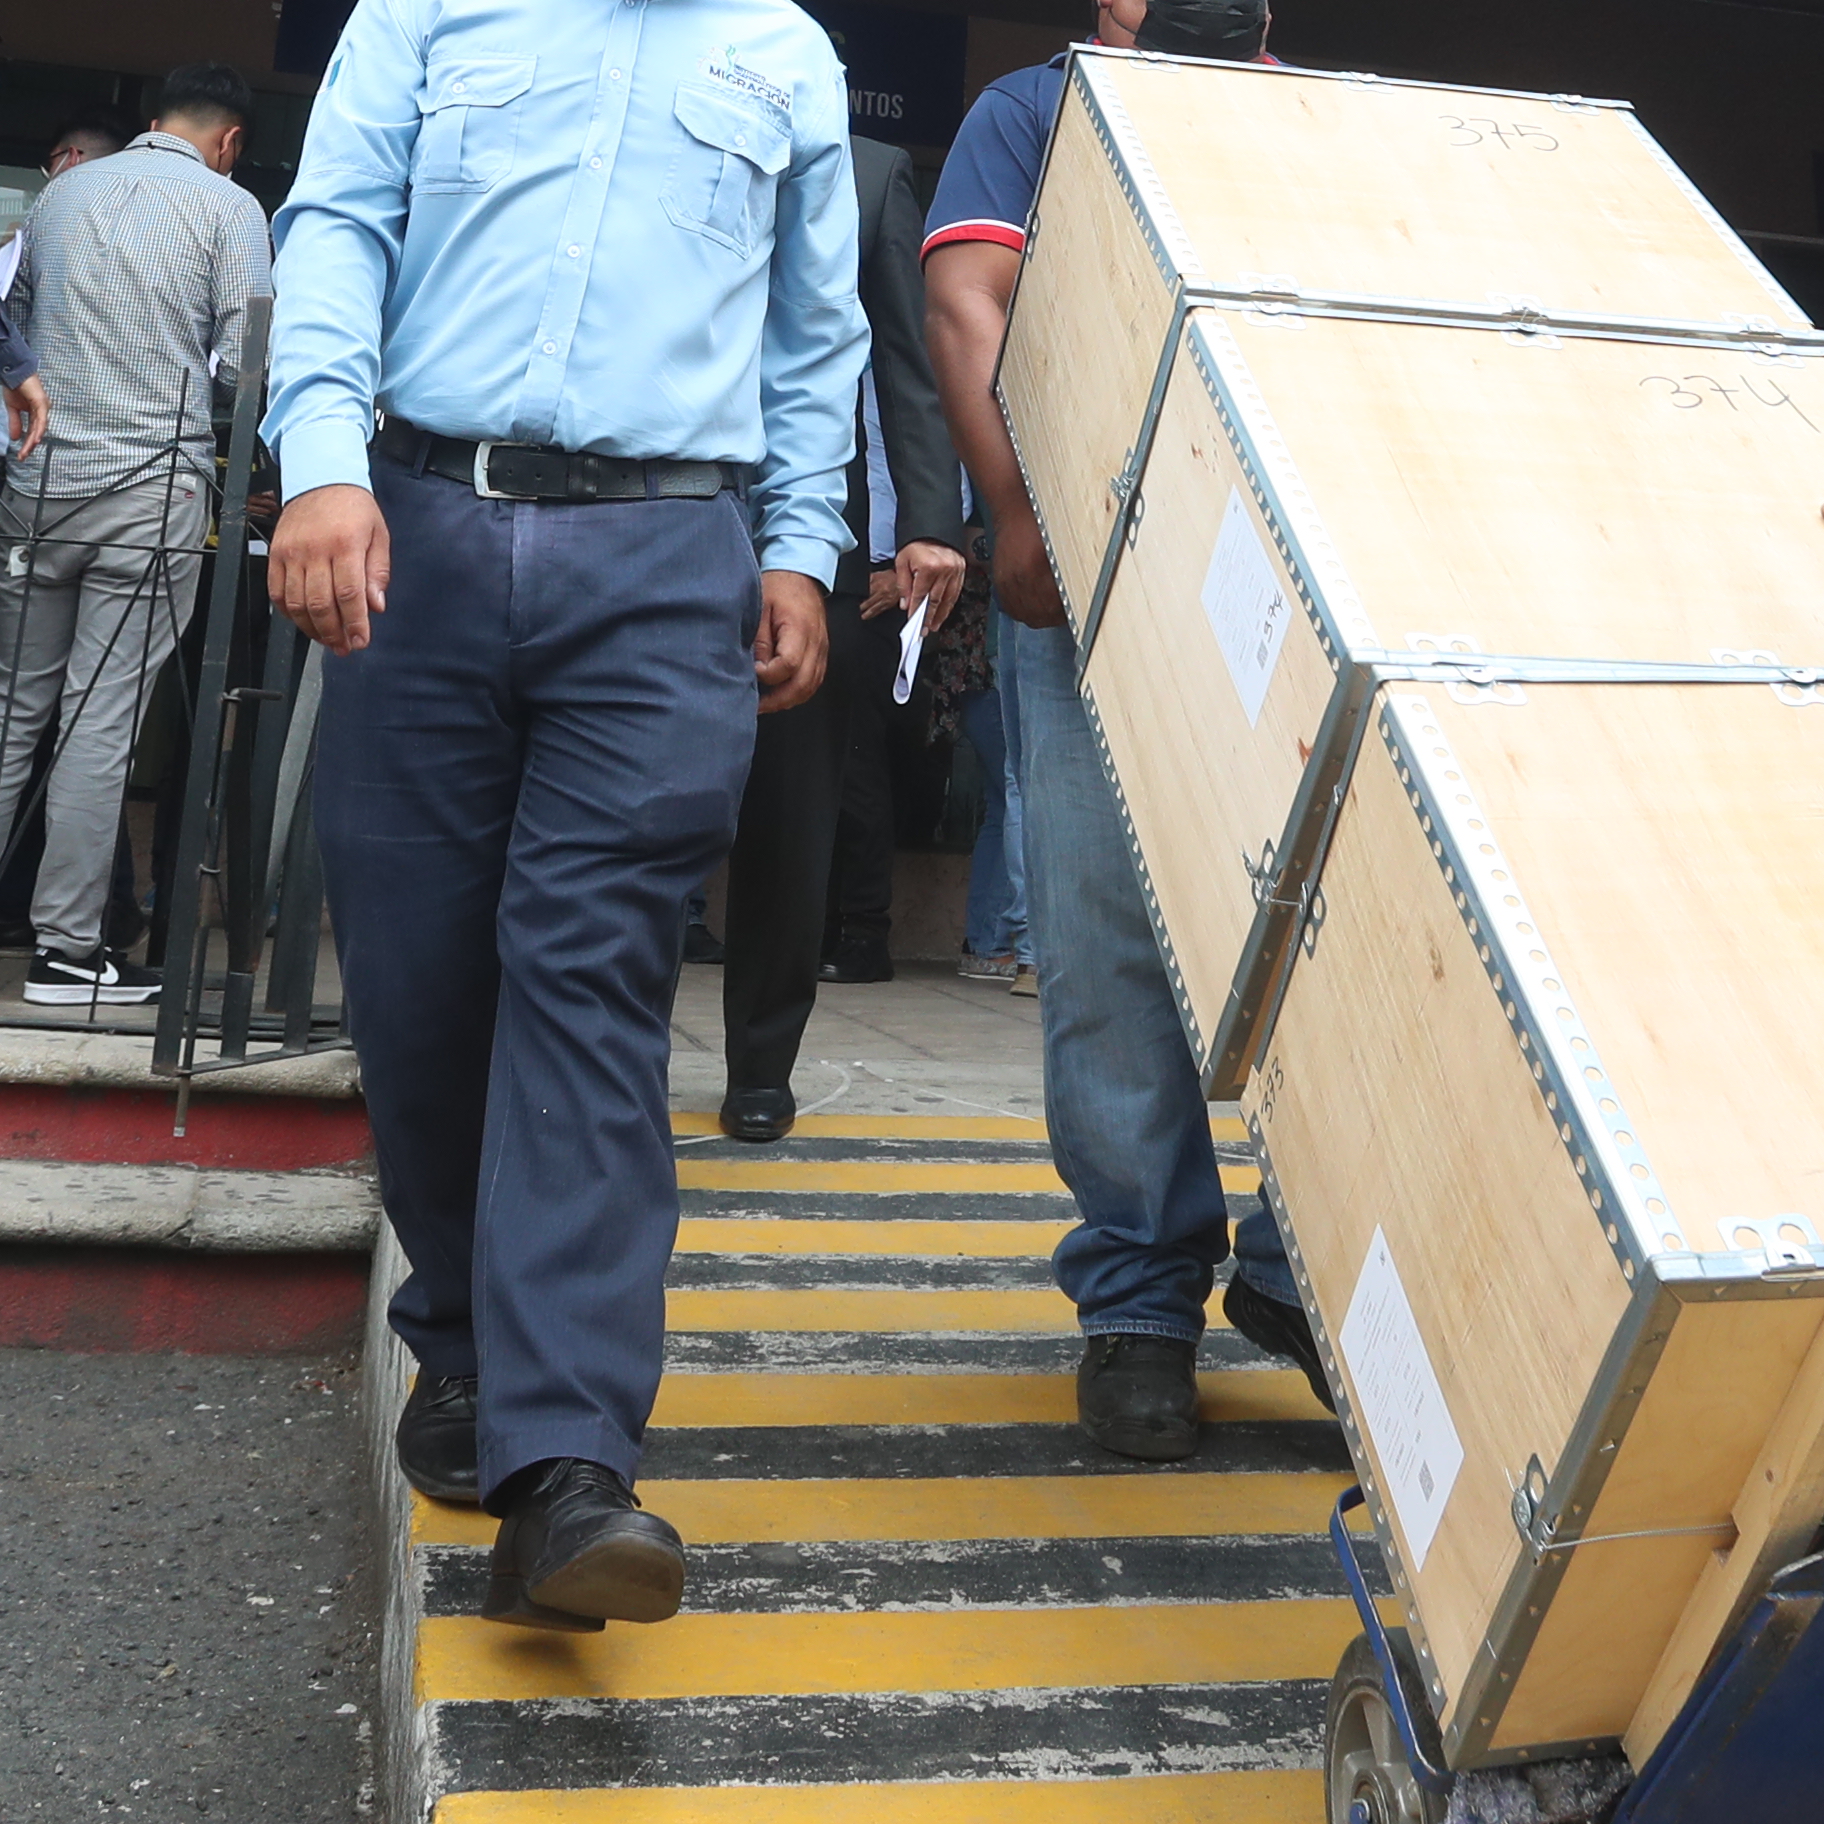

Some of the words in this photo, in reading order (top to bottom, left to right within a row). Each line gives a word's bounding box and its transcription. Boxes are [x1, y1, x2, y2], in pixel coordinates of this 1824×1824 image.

[850, 89, 904, 119] NTOS
[1438, 115, 1560, 152] 375
[1638, 375, 1821, 434] 374
